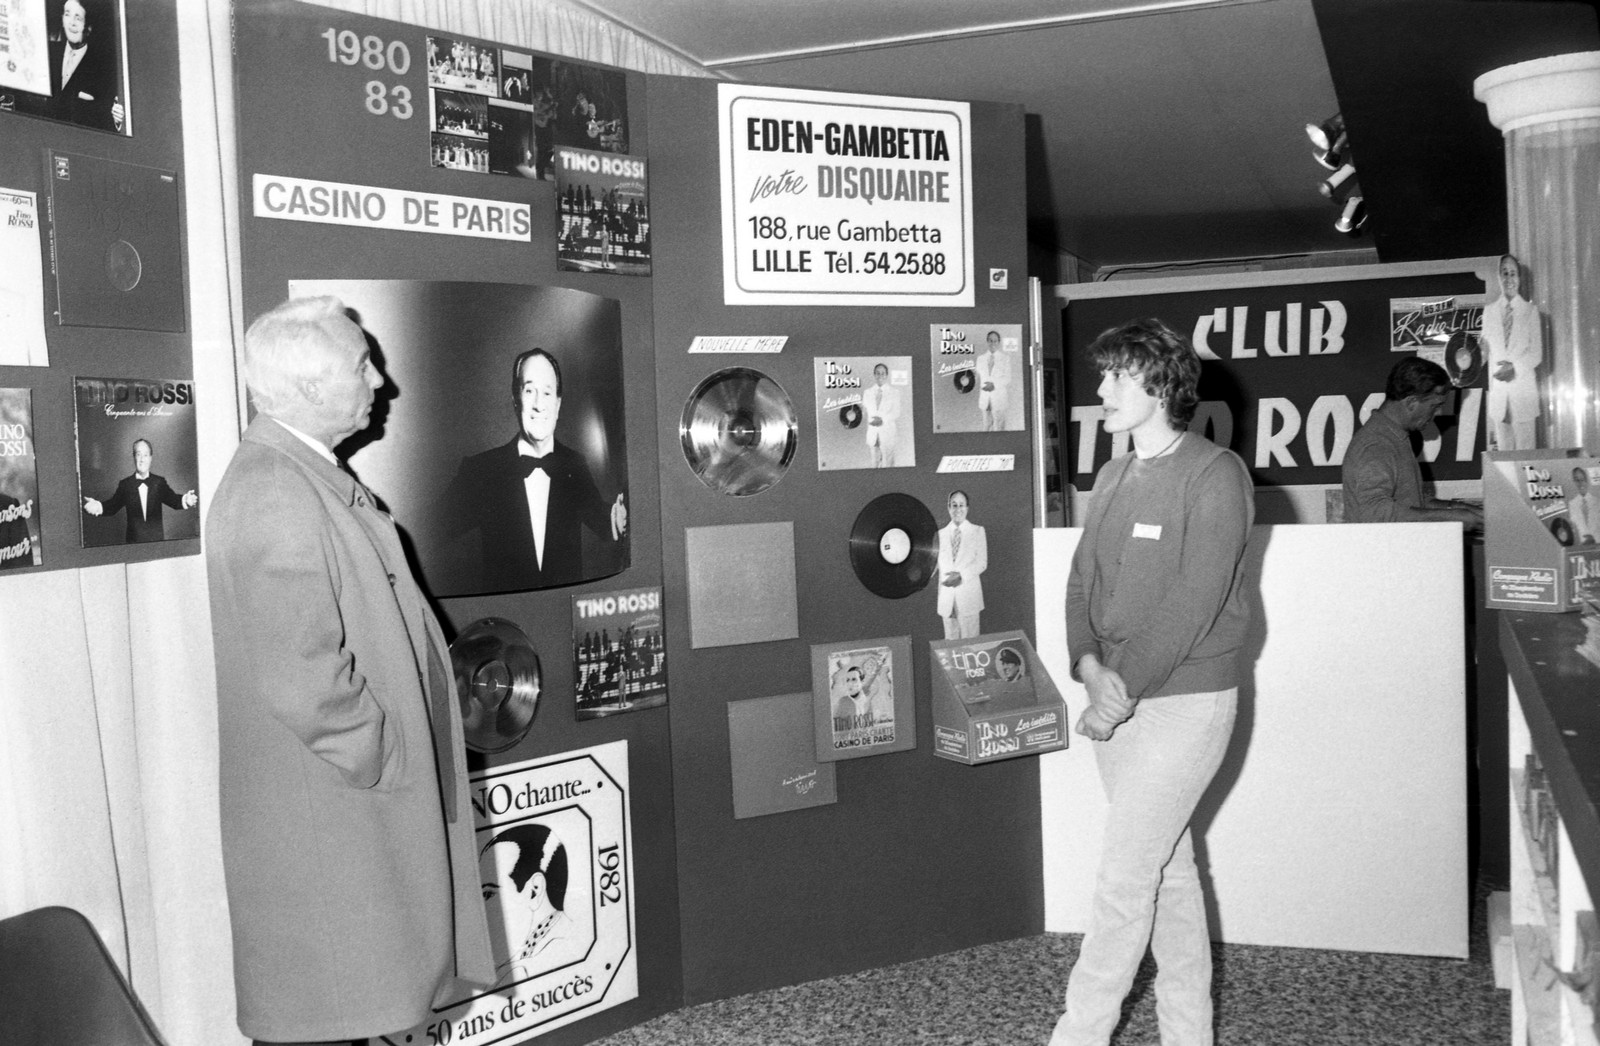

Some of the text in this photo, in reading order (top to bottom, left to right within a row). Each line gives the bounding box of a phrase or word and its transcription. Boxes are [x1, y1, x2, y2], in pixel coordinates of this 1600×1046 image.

[322, 28, 411, 75] 1980
[365, 80, 413, 120] 83
[746, 117, 950, 161] EDEN-GAMBETTA
[559, 151, 645, 180] TINO ROSSI
[817, 165, 950, 206] DISQUAIRE
[263, 182, 530, 236] CASINO DE PARIS
[748, 216, 942, 243] 188, rue Gambetta
[752, 249, 947, 275] LILLE Tél. 54.25.88
[695, 338, 754, 351] NOUVELLE
[1192, 300, 1348, 360] CLUB
[134, 383, 193, 405] ROSSI
[576, 592, 660, 618] TINO ROSSI
[833, 715, 852, 731] TINO
[853, 712, 874, 729] ROSSI
[833, 733, 895, 749] CASINO DE PARIS
[514, 779, 592, 811] chante...
[597, 841, 622, 908] 1982
[425, 974, 594, 1046] 50 ans de succès
